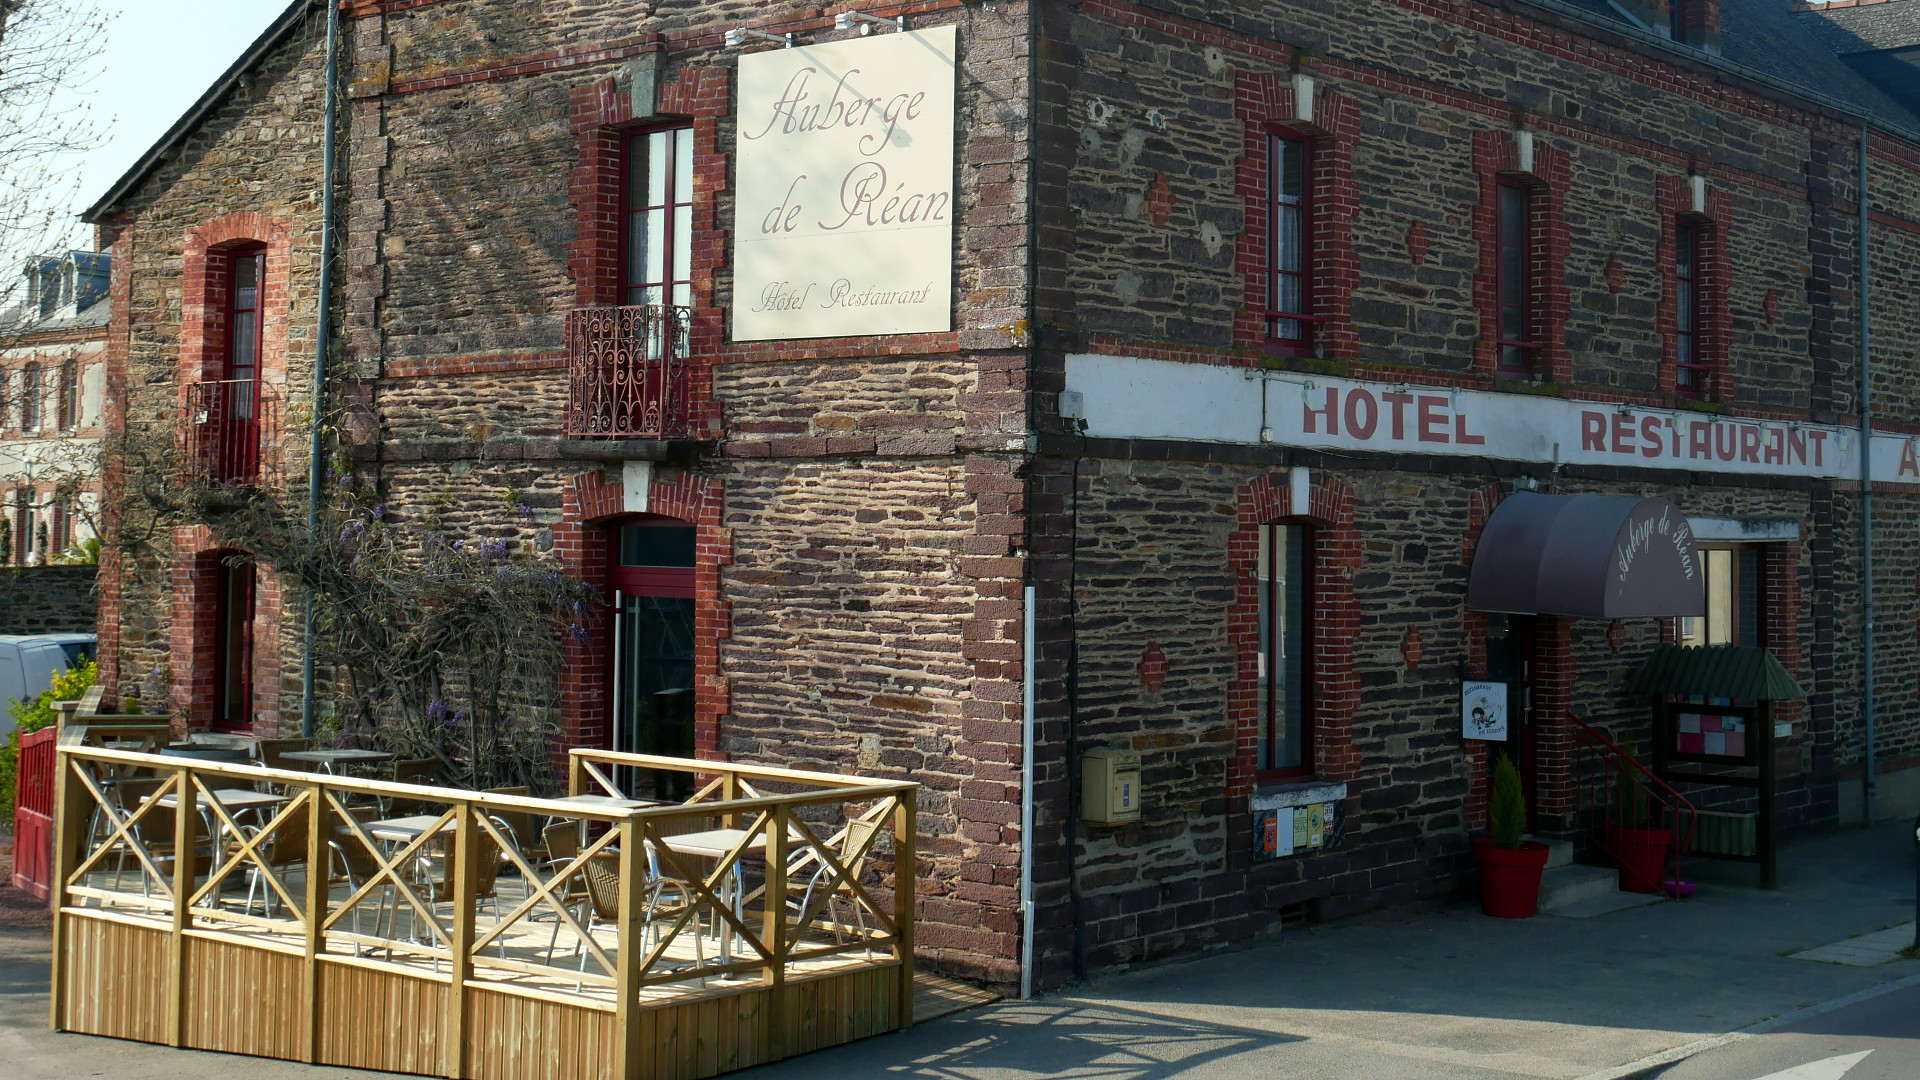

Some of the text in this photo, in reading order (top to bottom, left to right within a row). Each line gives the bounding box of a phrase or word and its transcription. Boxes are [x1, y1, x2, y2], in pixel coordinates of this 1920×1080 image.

[743, 67, 925, 156] Auberge
[761, 162, 949, 234] de Réan
[752, 278, 934, 312] Hôtel Restaurant
[1303, 387, 1485, 445] HOTEL
[1581, 411, 1827, 467] RESTAURANT
[1618, 504, 1694, 582] Auberge de Réan
